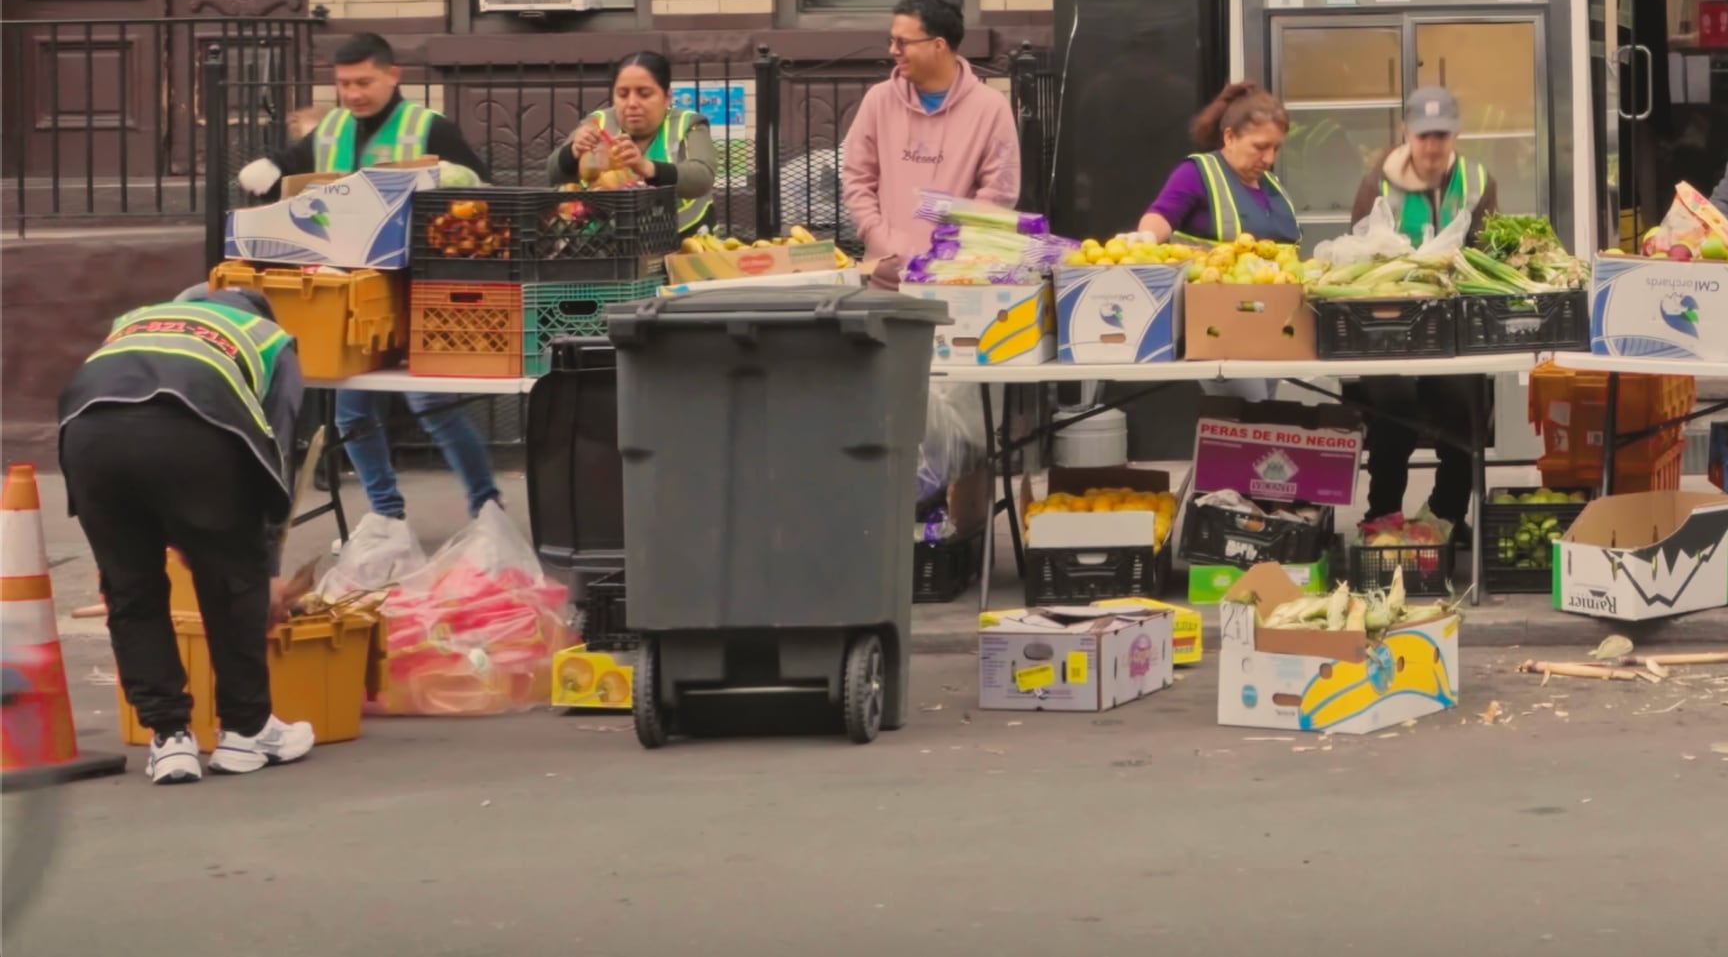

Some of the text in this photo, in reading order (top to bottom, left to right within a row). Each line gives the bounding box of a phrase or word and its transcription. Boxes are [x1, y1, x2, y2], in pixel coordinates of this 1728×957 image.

[902, 149, 944, 164] Blessed
[1694, 280, 1720, 292] CMI
[1200, 423, 1357, 449] PERAS DE RIO NEGRO
[1568, 595, 1617, 614] Rainier
